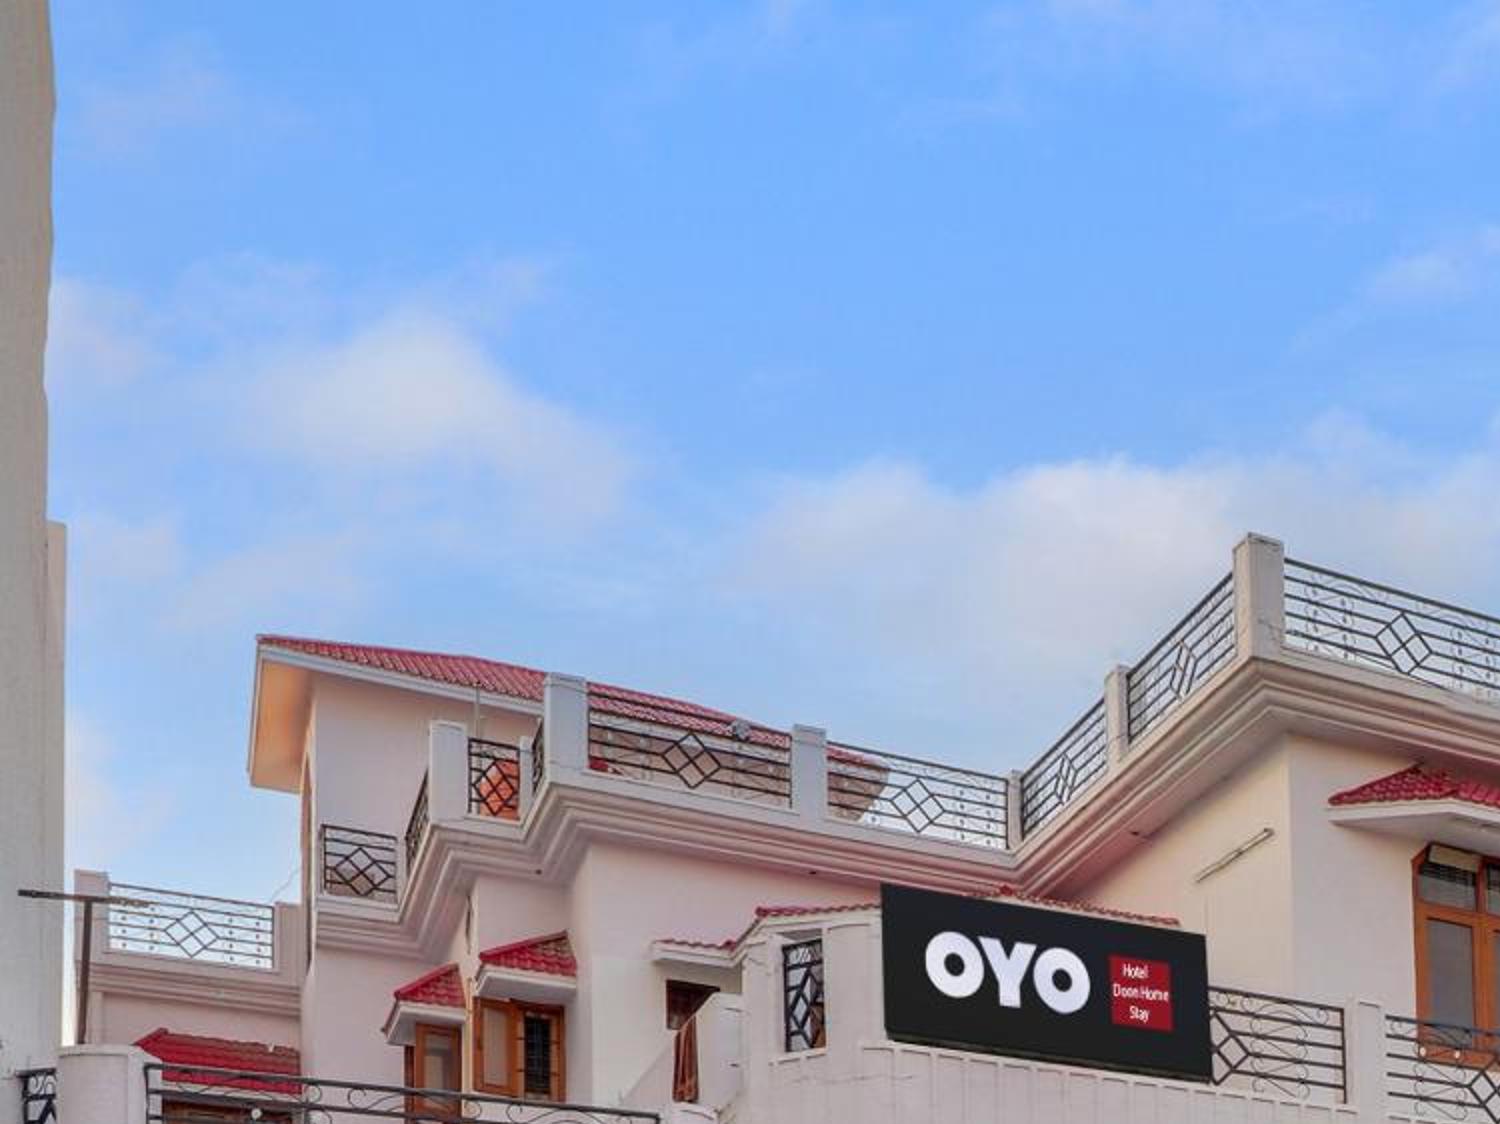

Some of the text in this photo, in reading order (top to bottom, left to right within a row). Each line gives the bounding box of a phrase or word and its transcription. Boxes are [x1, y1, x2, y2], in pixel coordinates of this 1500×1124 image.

[925, 930, 1091, 1015] OYO
[1122, 963, 1149, 979] Hotel
[1112, 983, 1169, 1002] Doon Home
[1129, 1005, 1150, 1024] Stay
